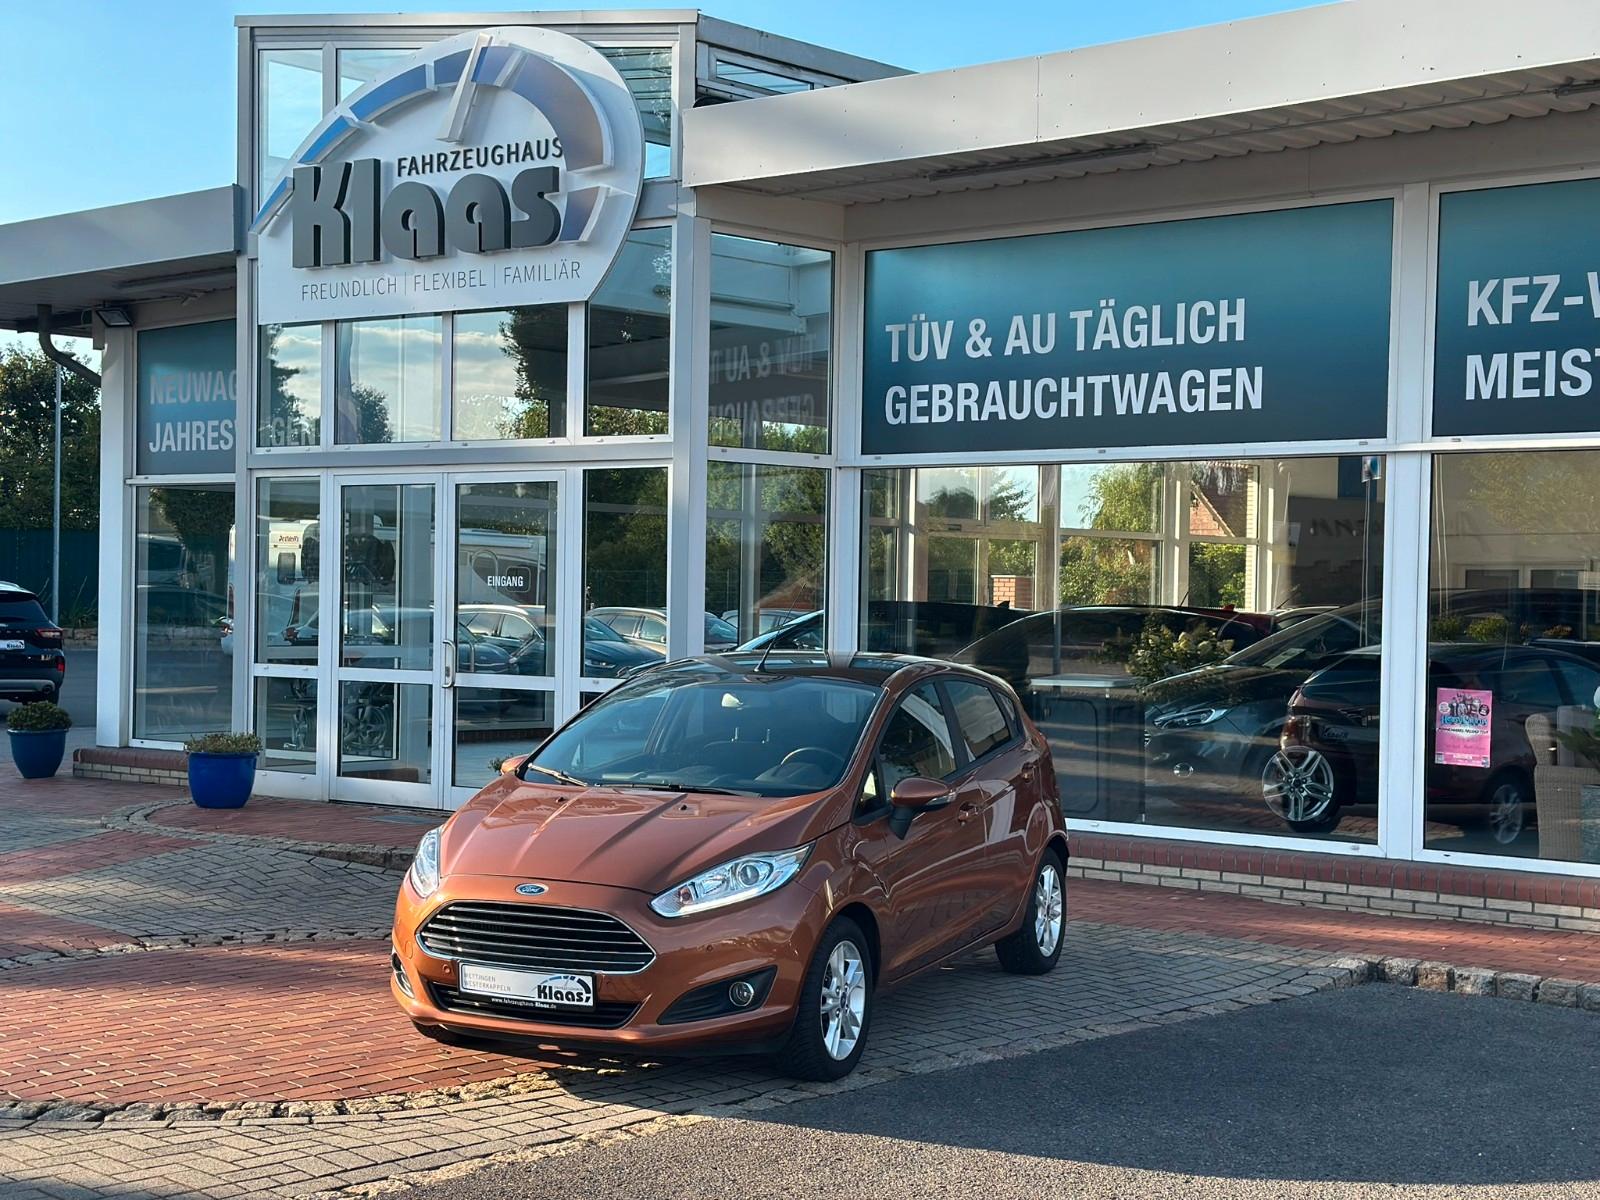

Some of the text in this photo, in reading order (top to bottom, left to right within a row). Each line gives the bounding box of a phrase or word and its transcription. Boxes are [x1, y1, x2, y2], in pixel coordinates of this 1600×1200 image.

[397, 136, 563, 178] FAHRZEUGHAUS
[291, 157, 561, 269] Klaas
[301, 258, 581, 301] FREUNDLICH FLEXIBEL FAMILIÄR
[885, 297, 1246, 363] TÜV & AU TÄGLICH
[884, 366, 1263, 426] GEBRAUCHTWAGEN
[487, 575, 524, 587] EINGANG
[537, 984, 584, 1003] Klaas
